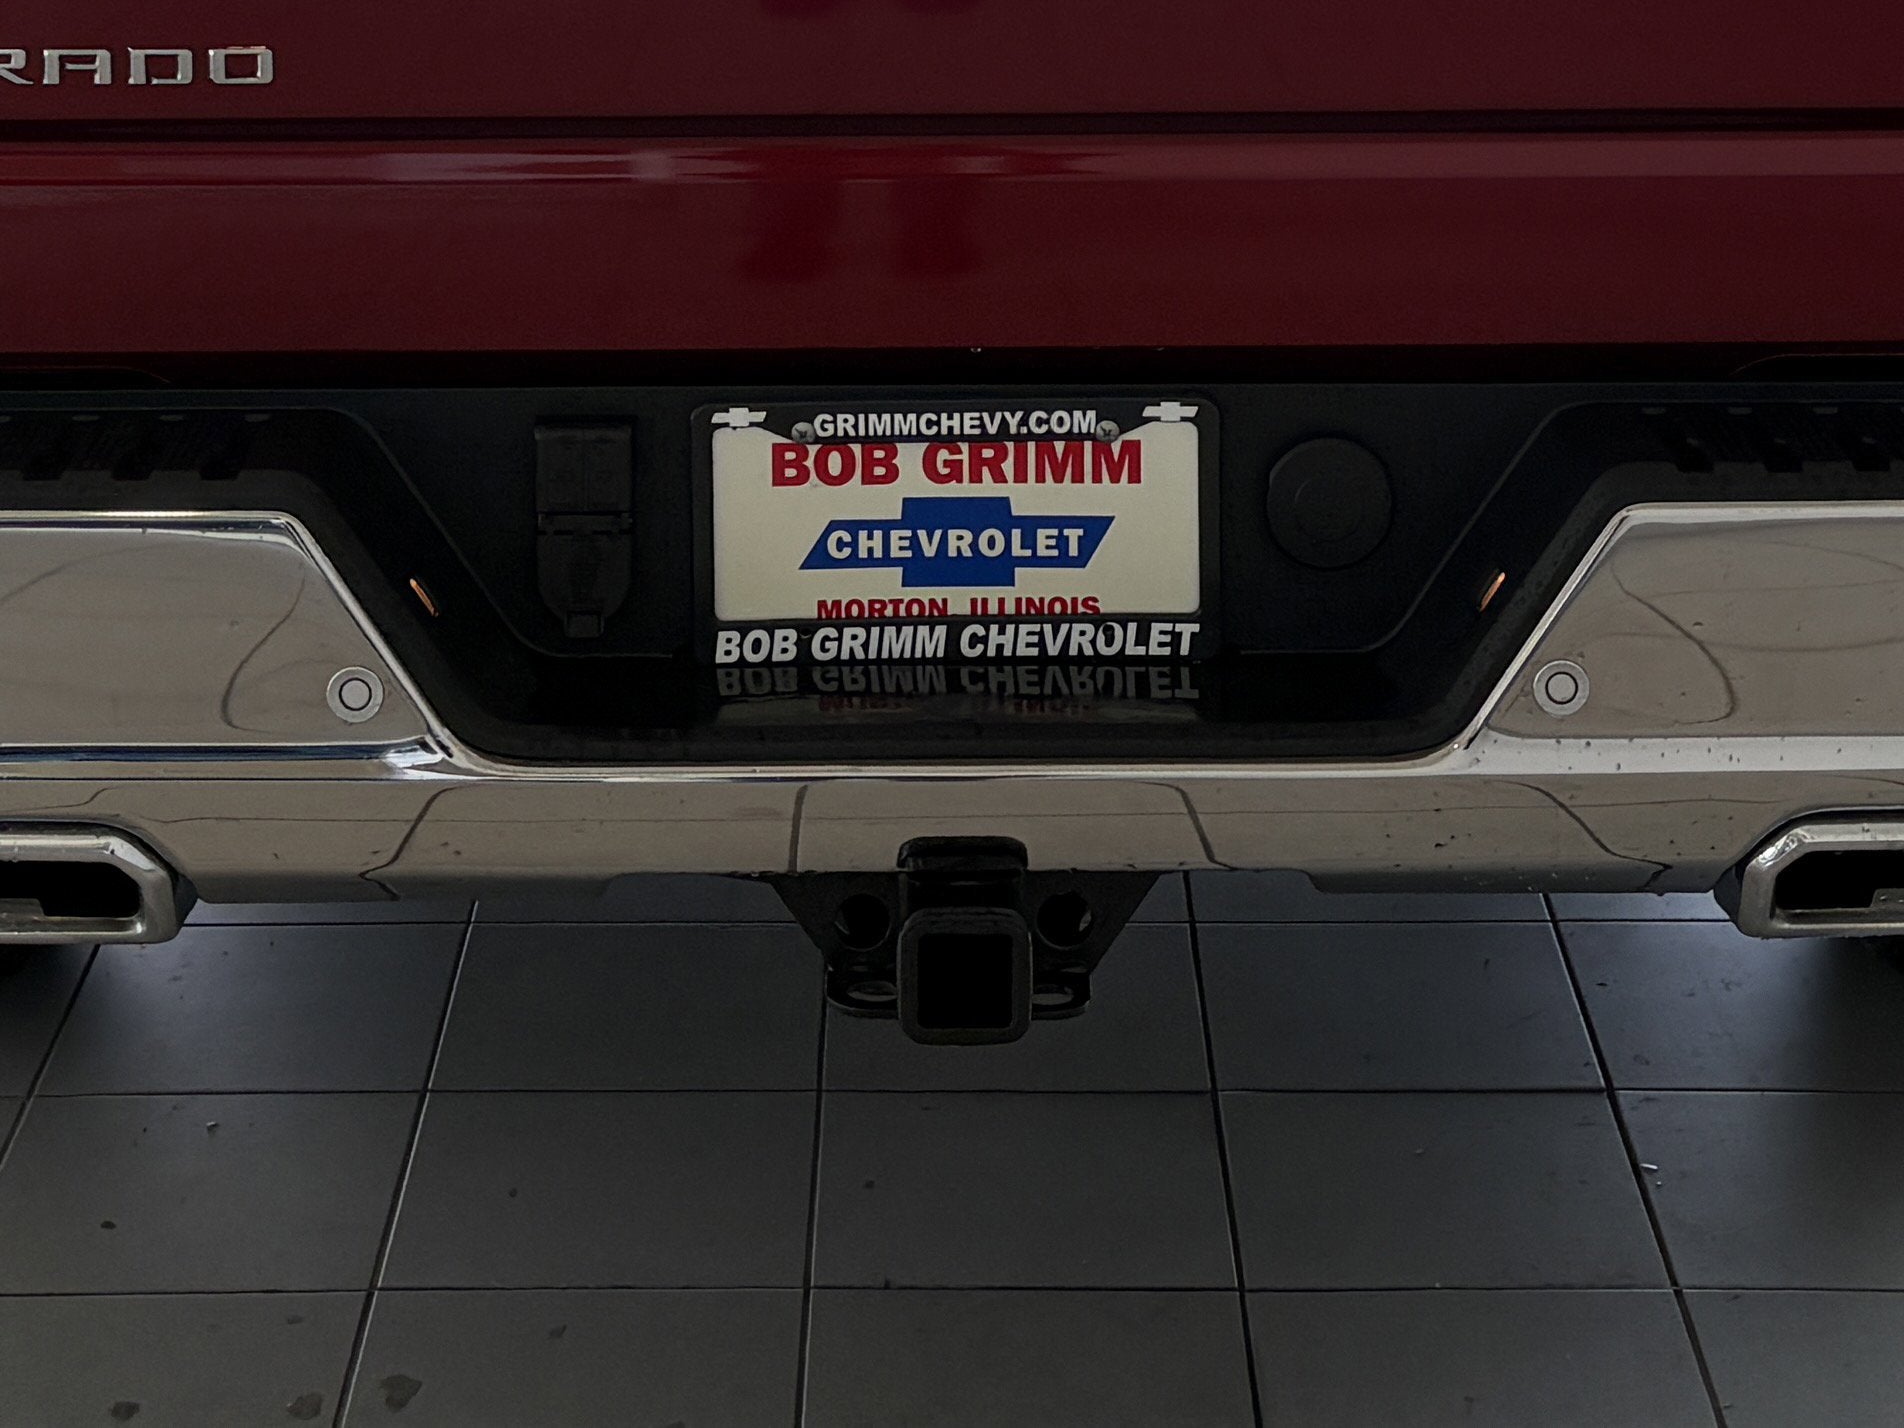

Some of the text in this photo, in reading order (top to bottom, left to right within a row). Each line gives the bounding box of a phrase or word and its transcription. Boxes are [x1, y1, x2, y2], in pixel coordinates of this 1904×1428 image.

[813, 410, 1097, 438] GRIMMCHEVY.COM
[772, 440, 1142, 487] BOB GRIMM
[827, 528, 1084, 560] CHEVROLET
[715, 622, 1201, 664] BOB GRIMM CHEVROLET
